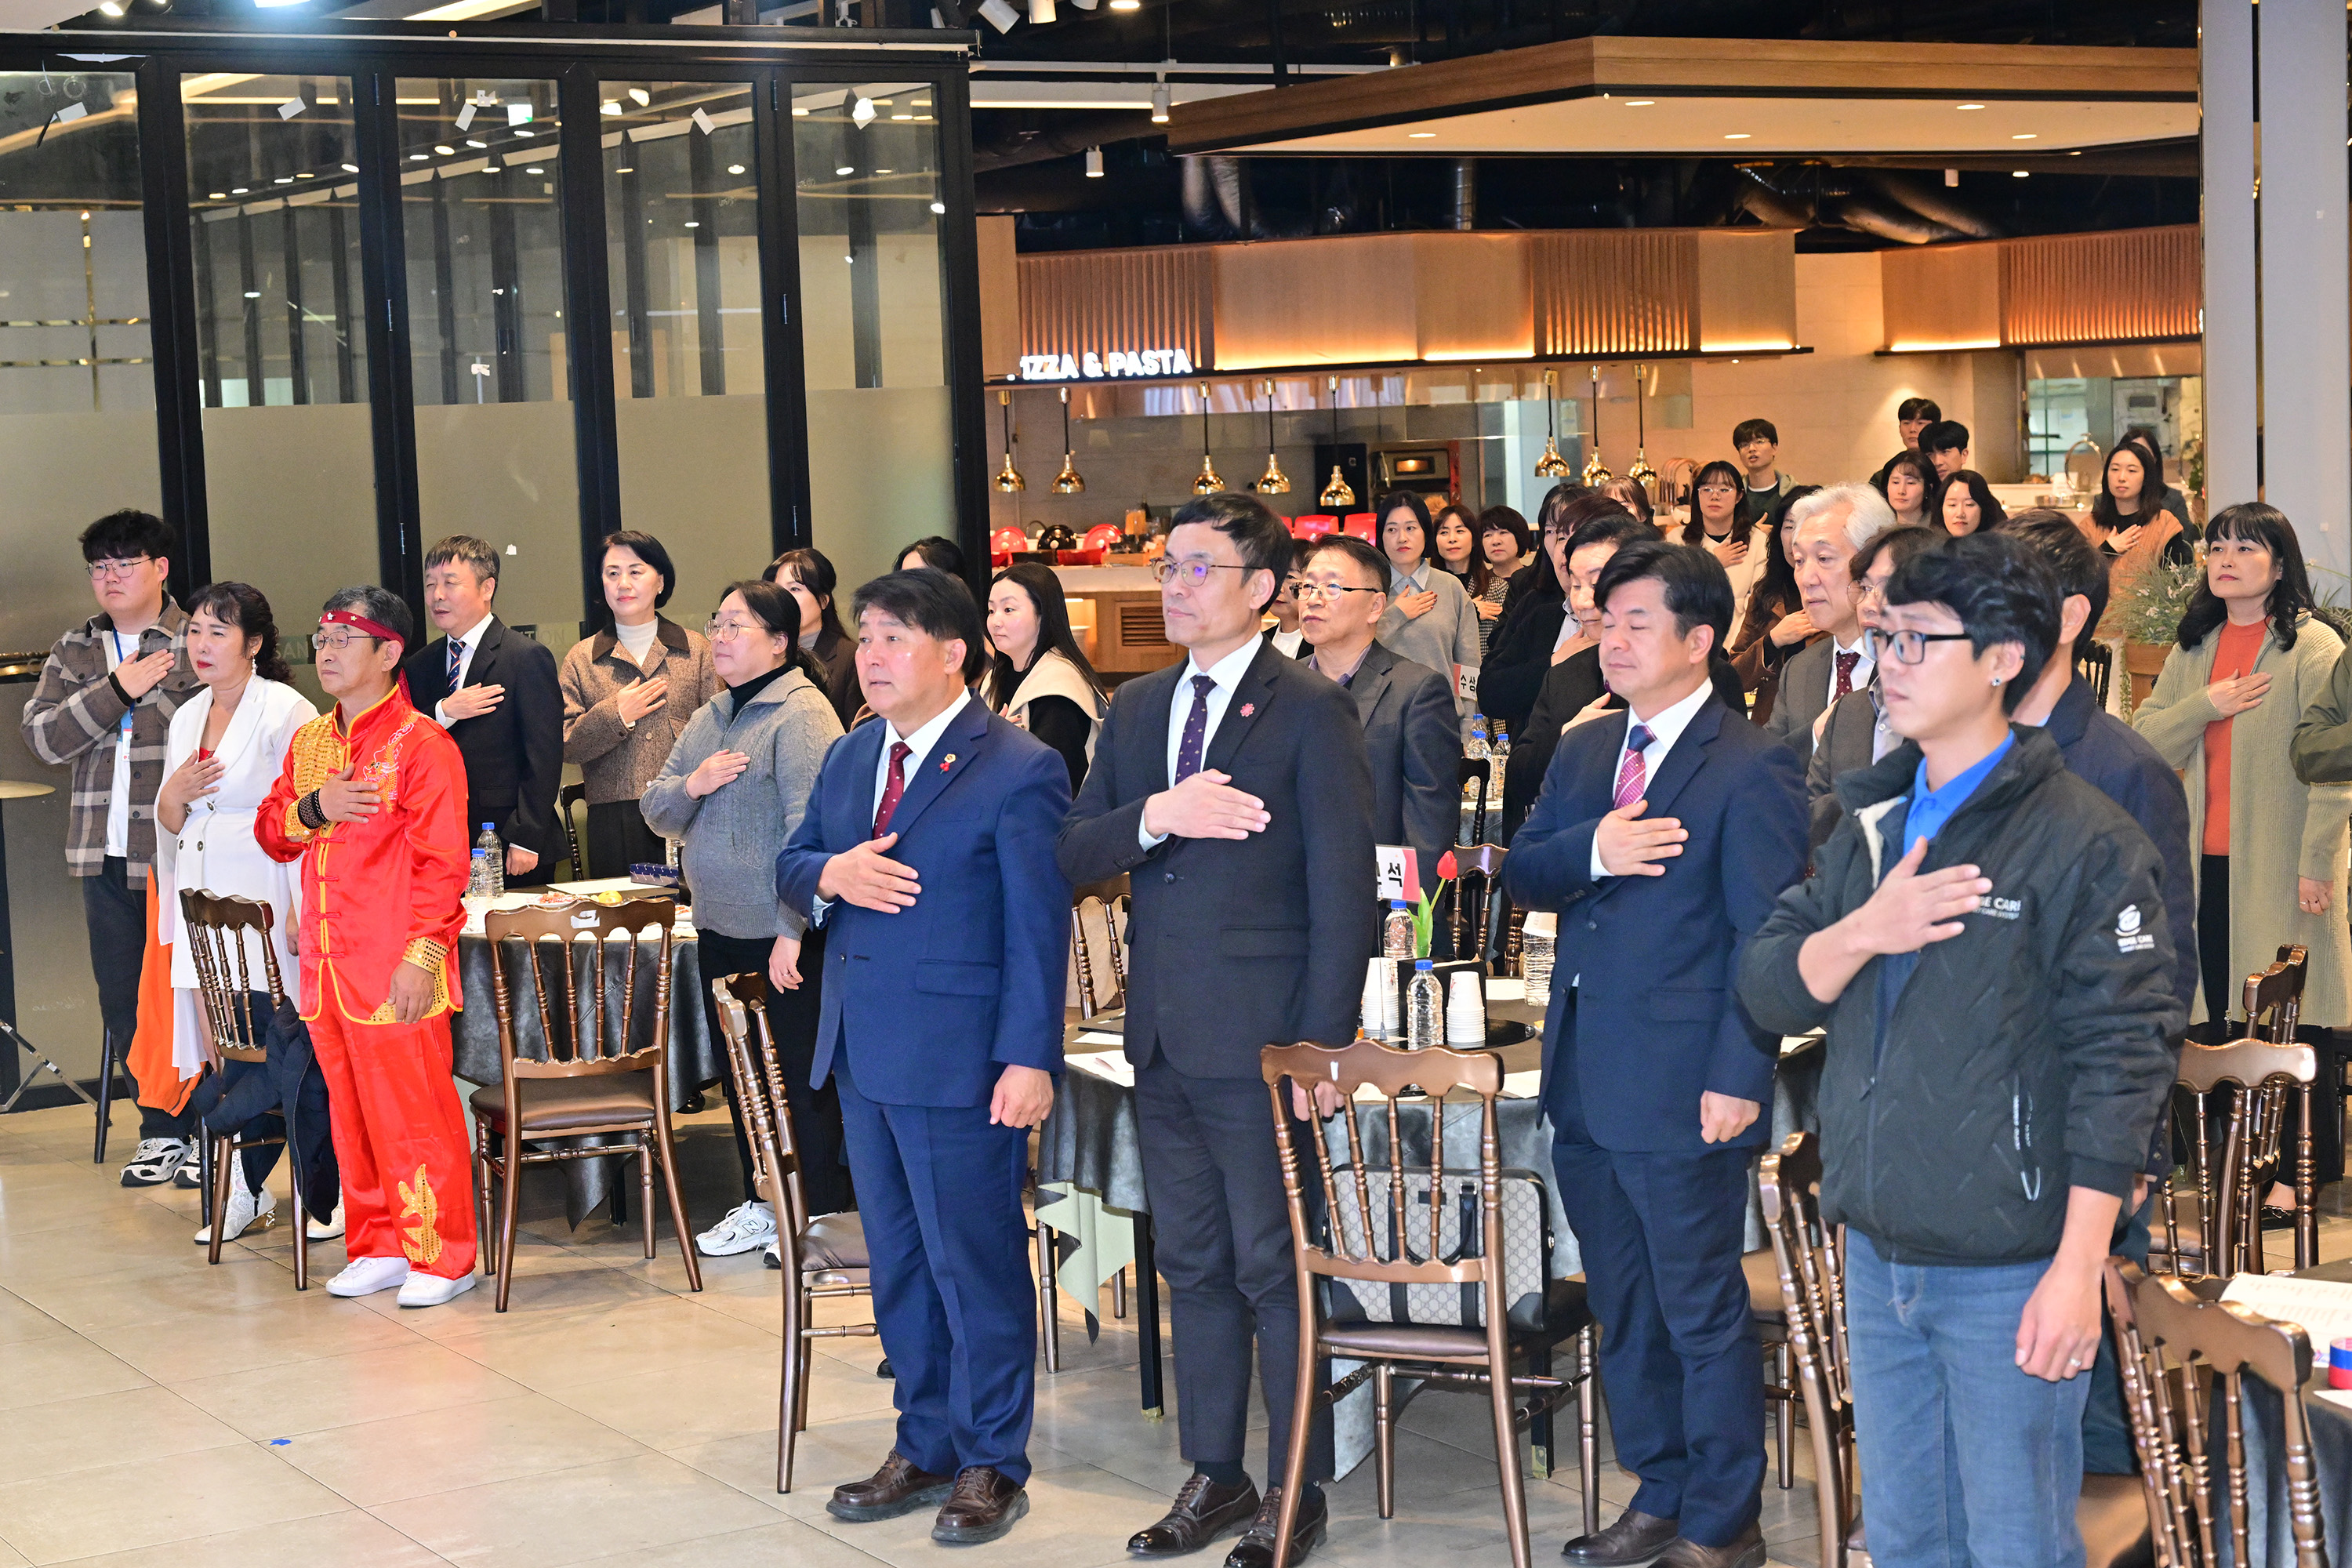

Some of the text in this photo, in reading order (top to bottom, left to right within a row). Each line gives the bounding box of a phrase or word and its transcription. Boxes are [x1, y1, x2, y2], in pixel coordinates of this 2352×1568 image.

[1007, 348, 1192, 382] IZZA & PASTA
